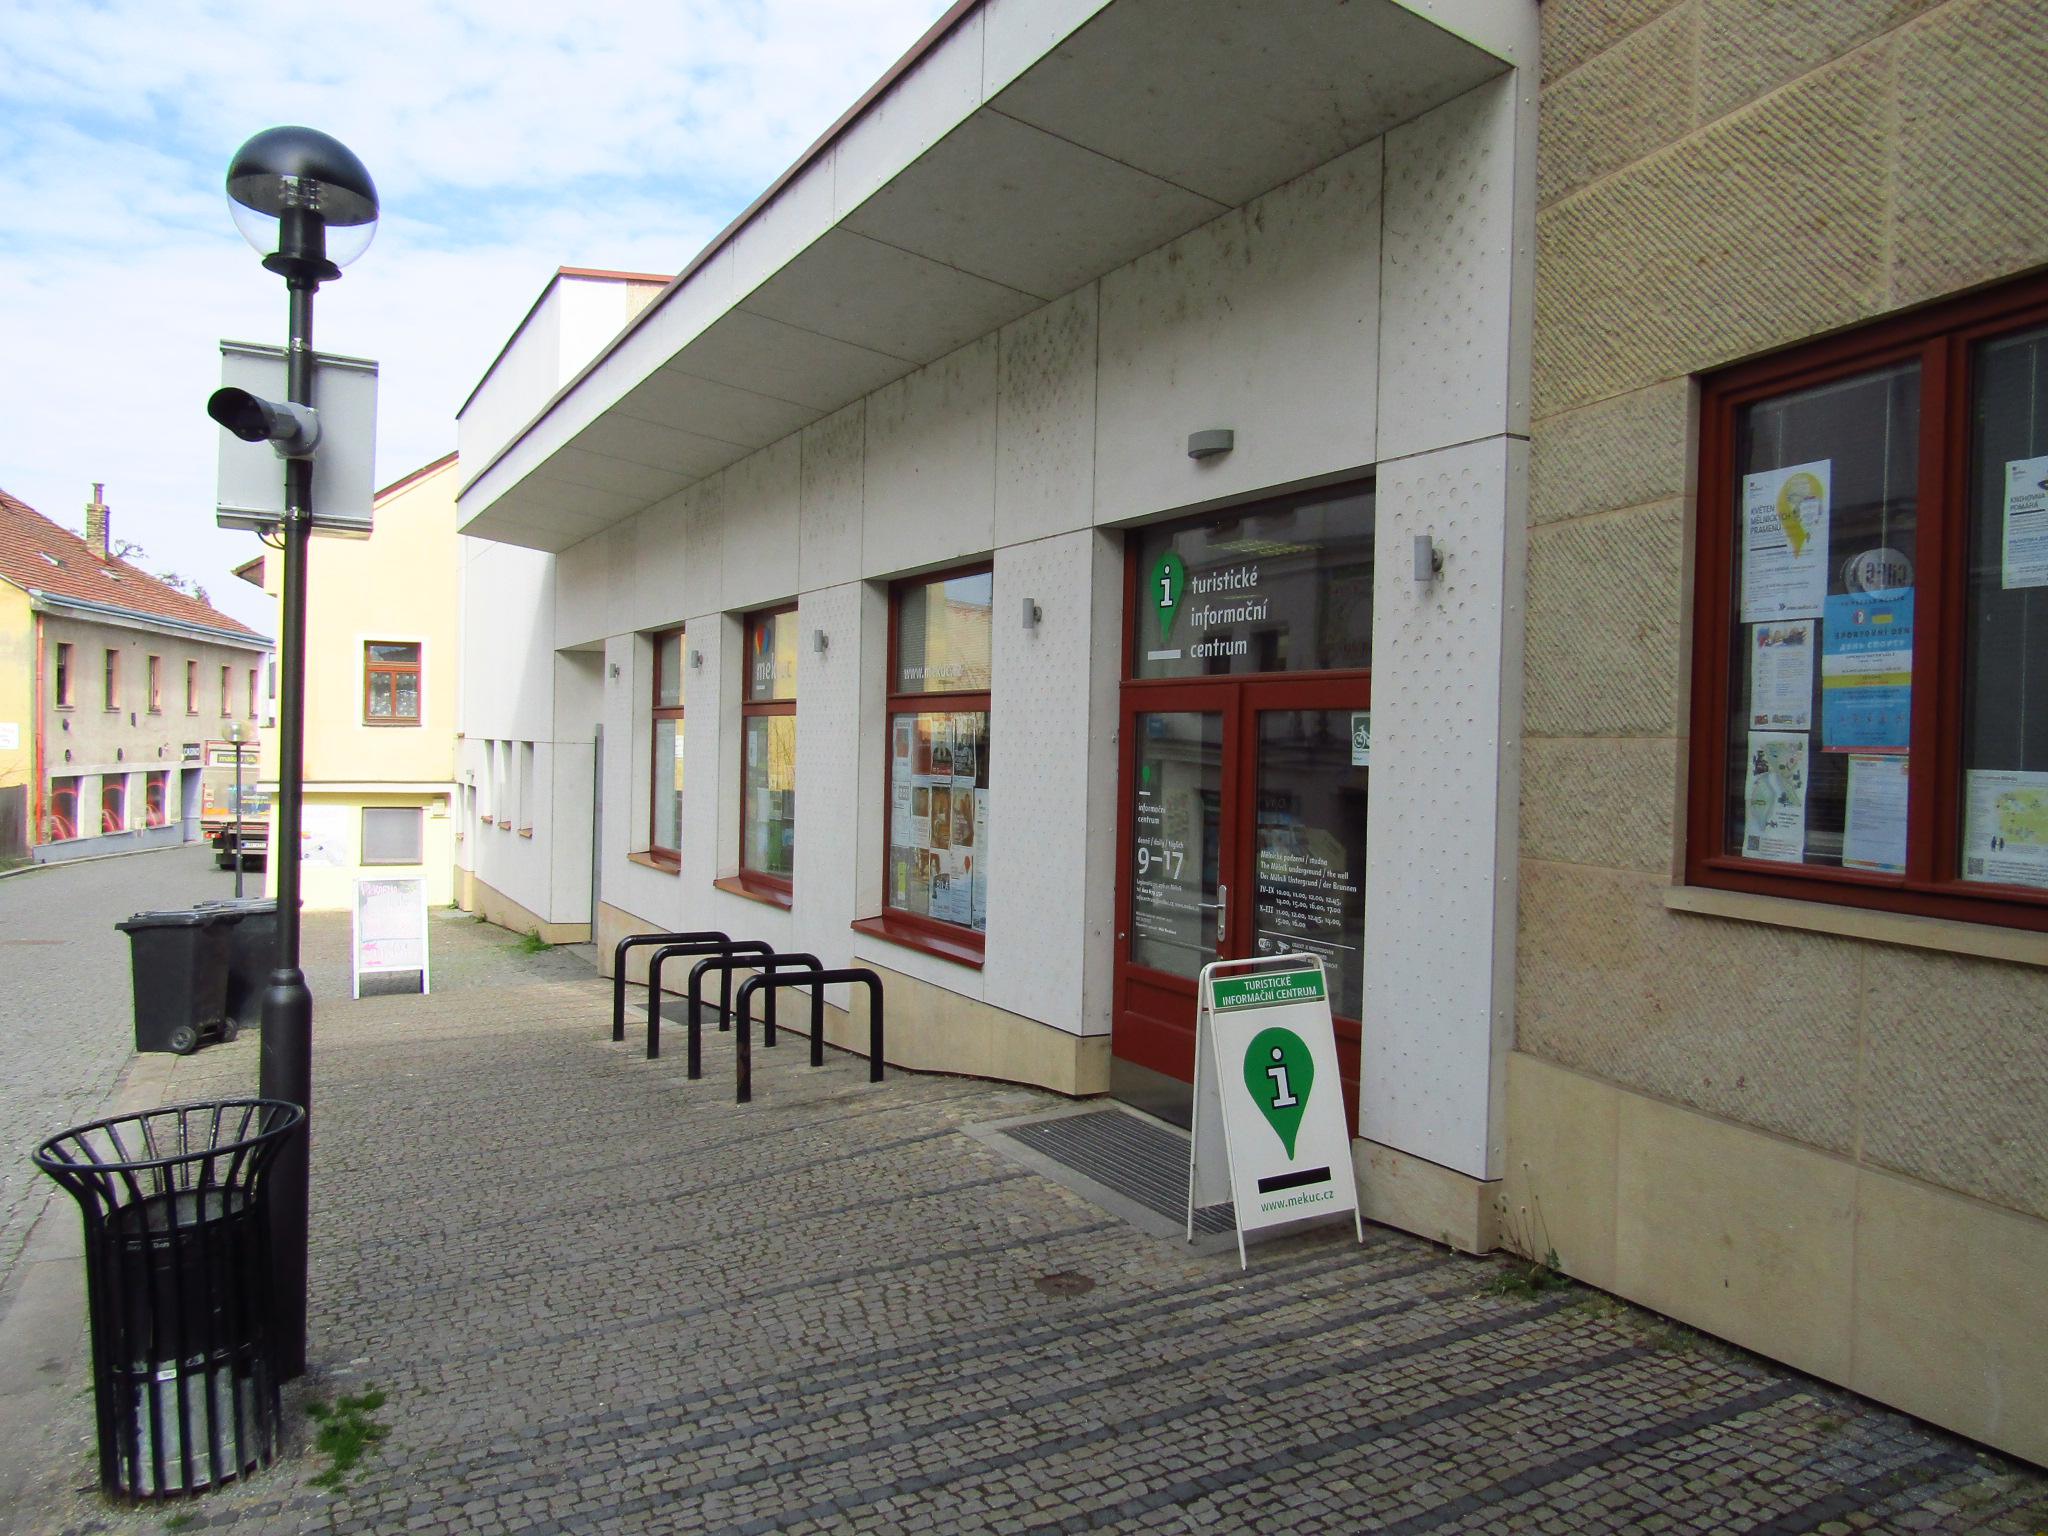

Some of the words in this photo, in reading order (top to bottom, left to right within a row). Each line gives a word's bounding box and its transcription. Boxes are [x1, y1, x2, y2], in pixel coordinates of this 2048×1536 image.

[1191, 565, 1258, 594] turistické
[1190, 598, 1268, 631] informační
[1190, 638, 1248, 658] centrum
[1137, 816, 1160, 825] centrum
[1261, 861, 1270, 870] The
[1288, 866, 1322, 876] underground
[1326, 869, 1336, 878] the
[1287, 876, 1318, 887] Untergrund
[1244, 975, 1292, 991] TURISTICKÉ
[1222, 989, 1274, 1006] INFORMAČNÍ
[1276, 986, 1317, 999] CENTRUM
[1260, 1190, 1334, 1213] www.mekuc.cz
